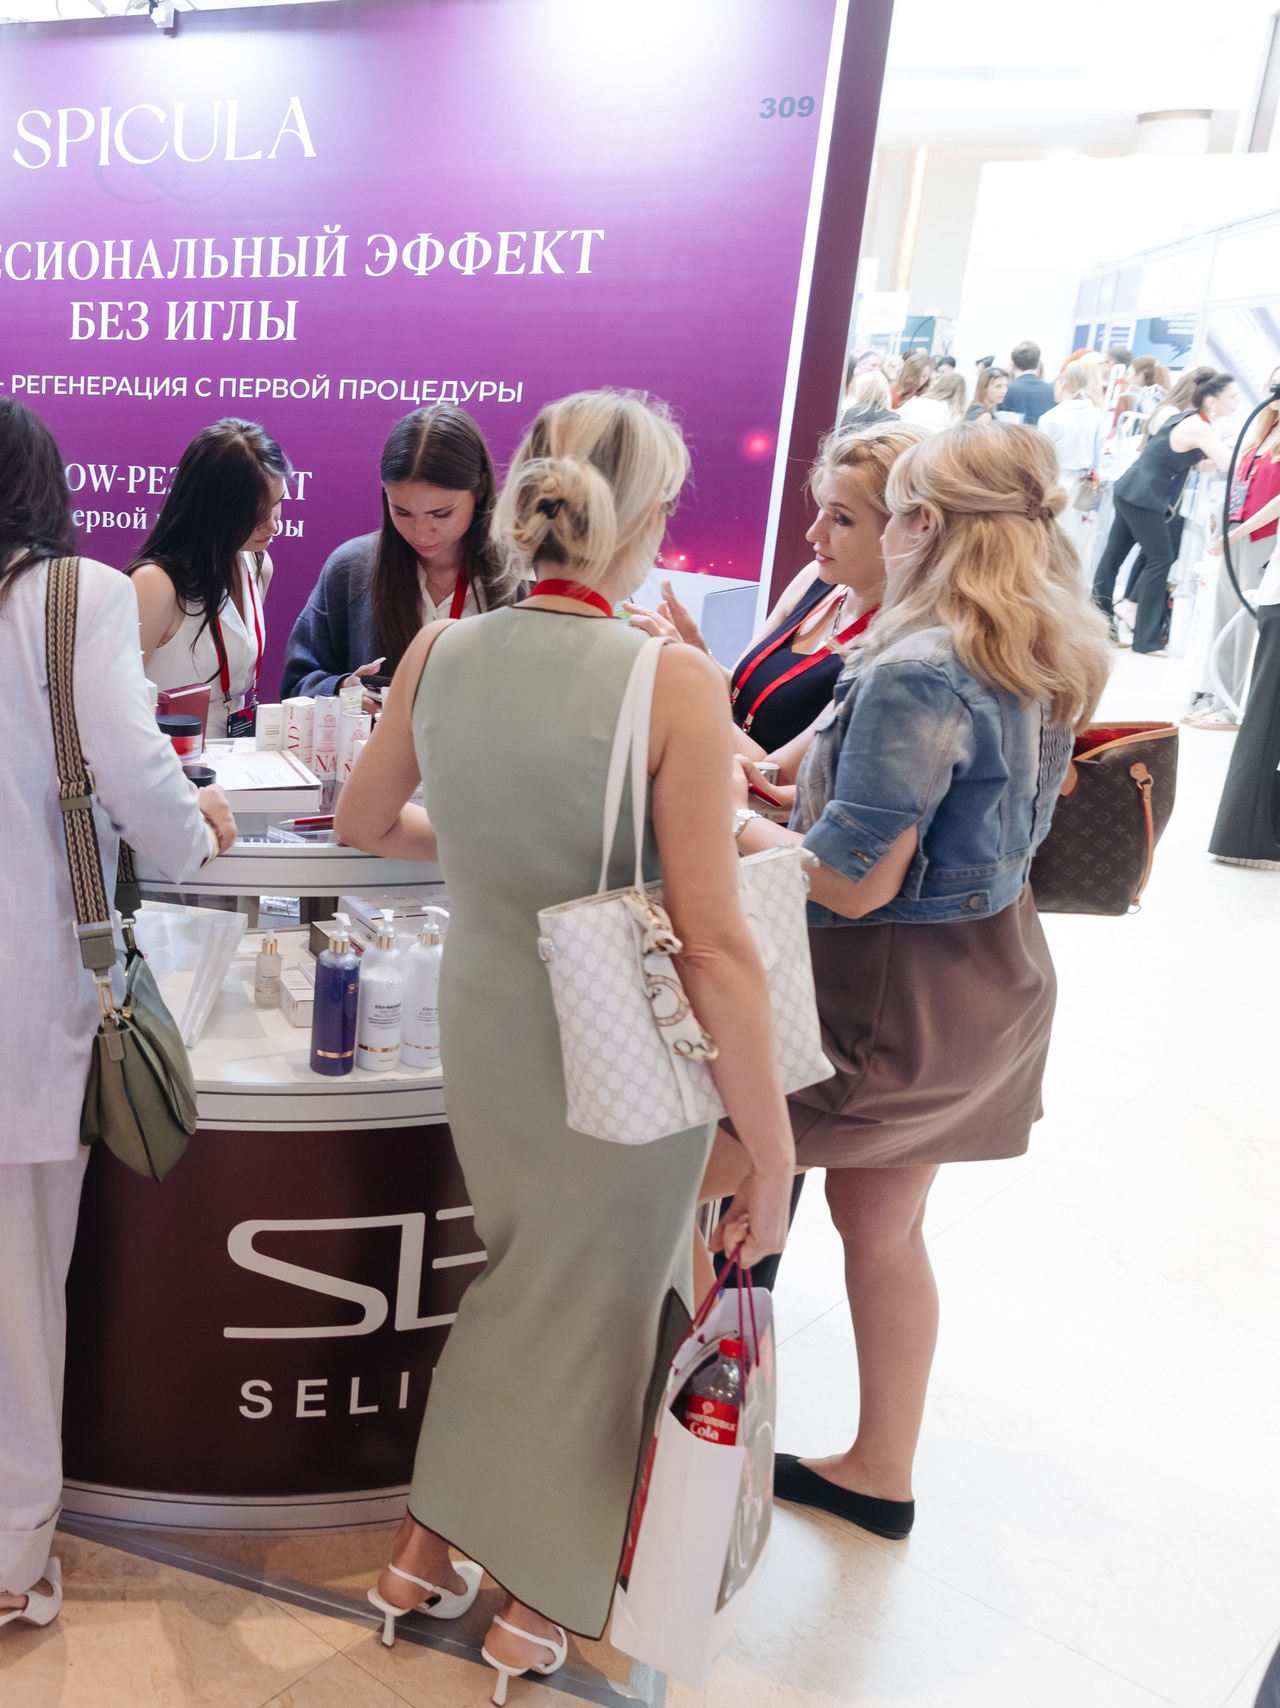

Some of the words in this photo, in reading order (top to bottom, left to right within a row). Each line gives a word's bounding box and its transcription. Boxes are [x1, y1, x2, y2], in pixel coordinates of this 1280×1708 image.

[759, 95, 815, 119] 309
[13, 97, 317, 169] SPICULA
[365, 229, 605, 276] ЭФФЕКТ
[69, 301, 150, 341] БЕЗ
[165, 300, 300, 341] ИГЛЫ
[11, 375, 187, 400] РЕГЕНЕРАЦИЯ
[195, 377, 212, 398] С
[219, 374, 330, 399] ПЕРВОЙ
[338, 378, 523, 405] ПРОЦЕДУРЫ
[72, 507, 147, 533] ервой
[239, 1368, 436, 1419] SELI
[689, 1421, 719, 1441] Cola
